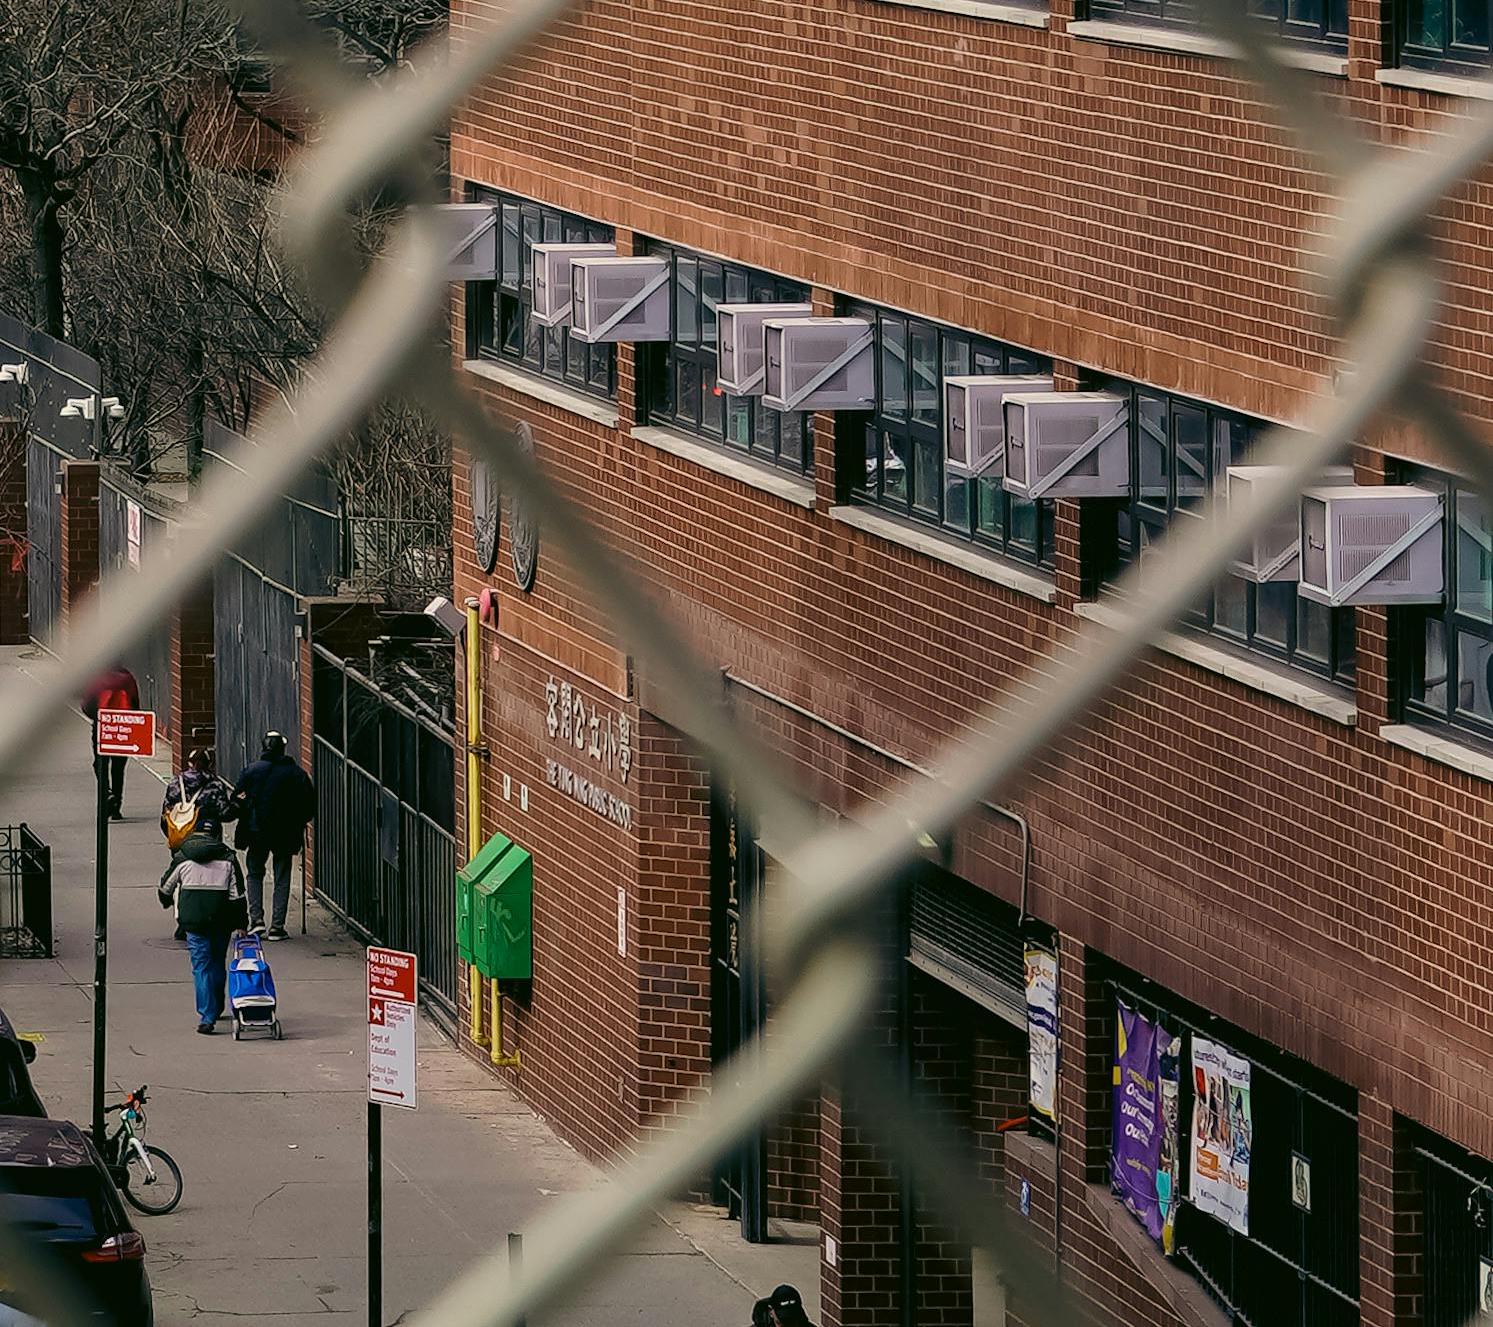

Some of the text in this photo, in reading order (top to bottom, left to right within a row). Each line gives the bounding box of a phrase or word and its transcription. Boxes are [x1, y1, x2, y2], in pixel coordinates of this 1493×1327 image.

[101, 714, 146, 725] NO STANDING
[370, 952, 409, 969] NO STANDING
[370, 964, 398, 978] School Days
[371, 1044, 397, 1057] Education
[371, 1063, 398, 1077] School Days
